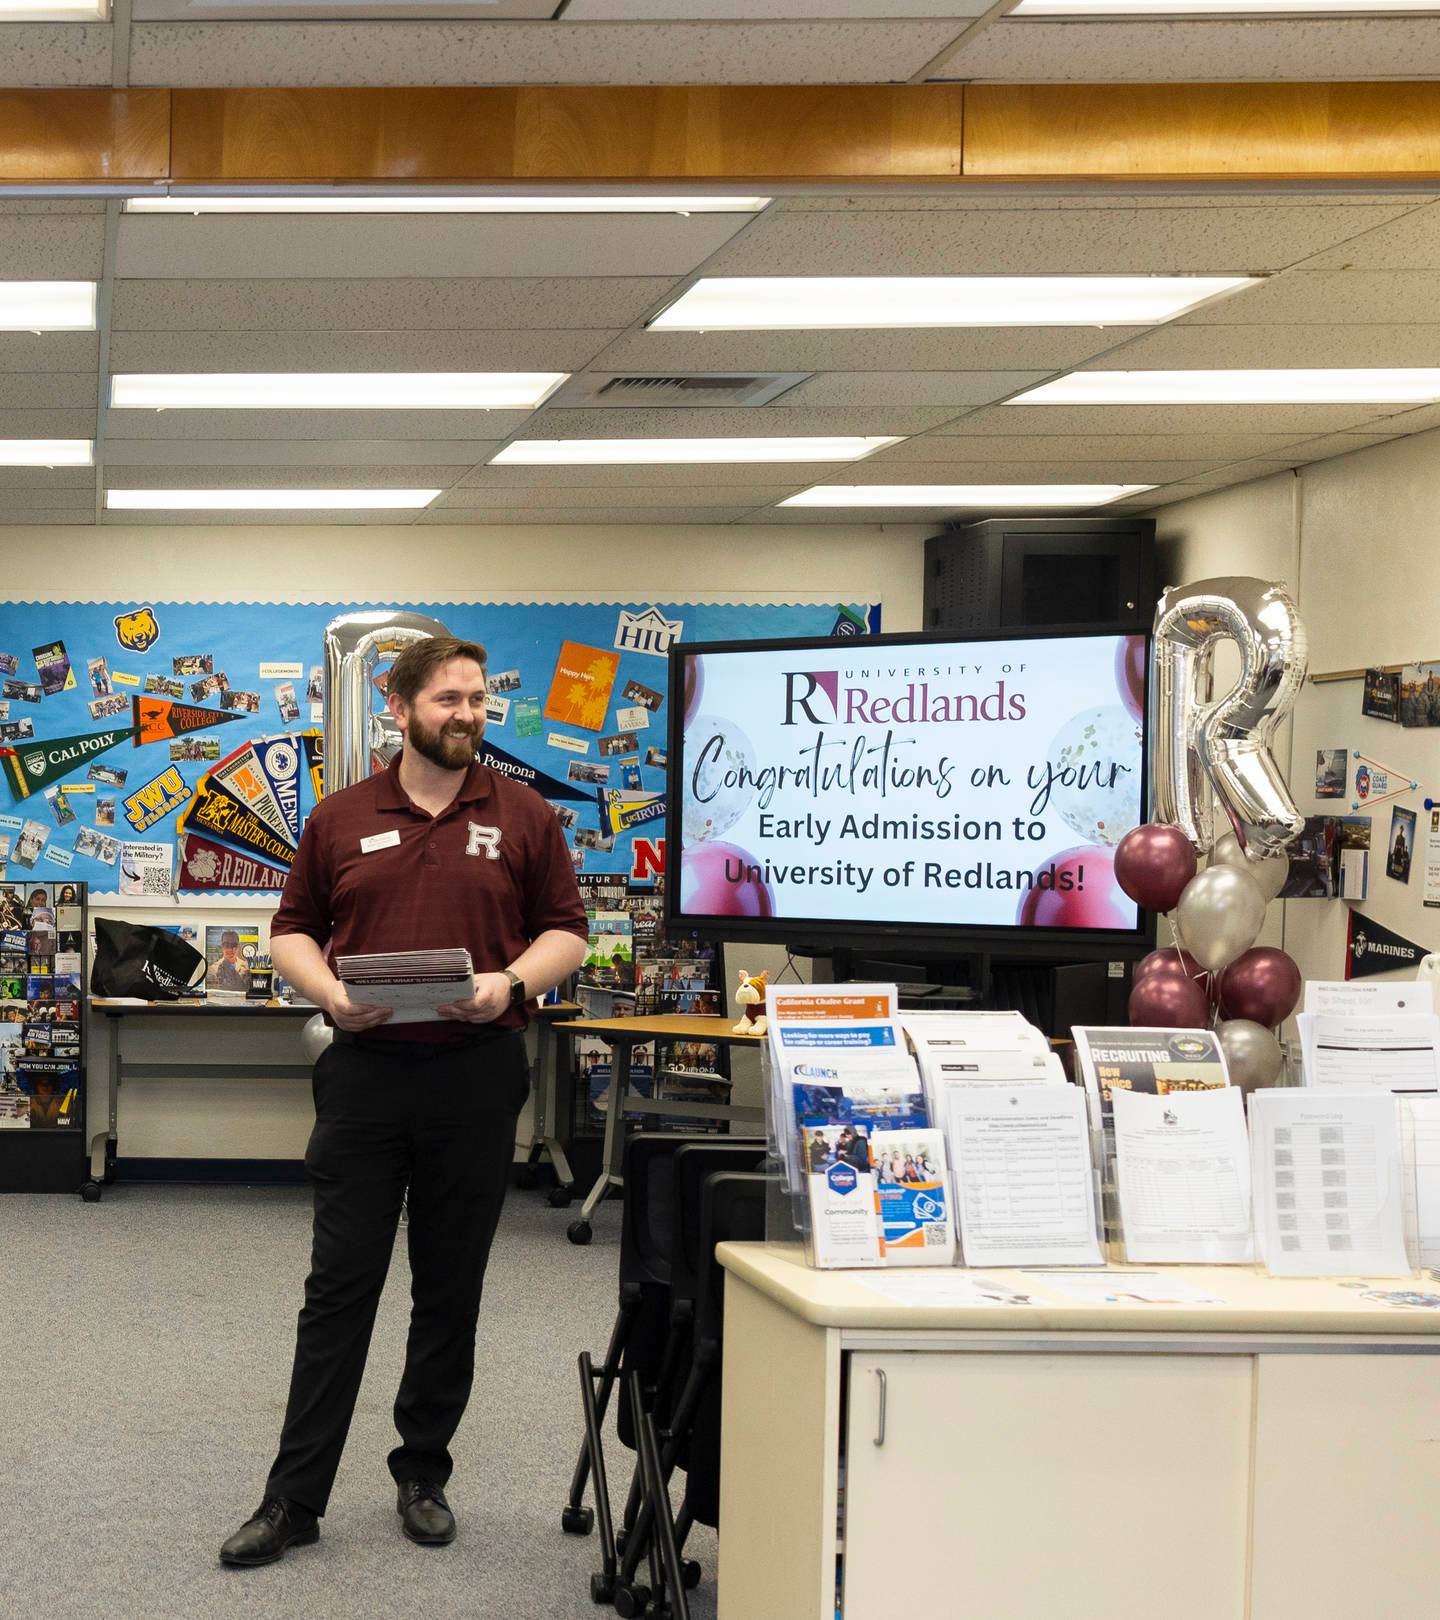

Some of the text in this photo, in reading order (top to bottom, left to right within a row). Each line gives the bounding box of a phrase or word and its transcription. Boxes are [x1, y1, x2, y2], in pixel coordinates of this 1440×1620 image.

[619, 625, 676, 653] HIU
[559, 666, 580, 680] Happy
[844, 663, 1029, 680] UNIVERSITY OF
[780, 671, 1027, 726] R Redlands
[171, 706, 206, 719] RIVERSIDE
[180, 717, 217, 730] COLLEGE
[48, 733, 116, 764] CAL POLY
[482, 753, 536, 780] Pomona
[692, 729, 1132, 816] Congratulations on your
[1372, 775, 1388, 783] COAST
[1372, 782, 1388, 790] GUARD
[124, 766, 184, 822] JWU
[134, 786, 193, 832] WILDCATS
[273, 777, 299, 833] MENLO
[636, 800, 667, 822] IRVIN
[246, 811, 260, 825] THE
[252, 793, 290, 841] PIONEERS
[228, 812, 269, 848] MASTER'S
[759, 812, 1046, 846] Early Admission to
[465, 820, 503, 860] R
[122, 851, 163, 860] the Military?
[632, 838, 666, 880] N
[724, 858, 1085, 893] University of Redlands!
[1367, 941, 1415, 960] MARINES
[252, 980, 268, 989] NAVY
[354, 977, 393, 985] WELCOME
[776, 998, 814, 1006] California
[843, 997, 865, 1005] Grant
[782, 1032, 808, 1040] Looking
[1090, 1049, 1172, 1063] RECRUITING
[18, 1062, 31, 1070] HOW
[43, 1063, 56, 1071] CAN
[1098, 1066, 1121, 1078] New
[1100, 1077, 1133, 1090] Police
[824, 1208, 868, 1217] Community
